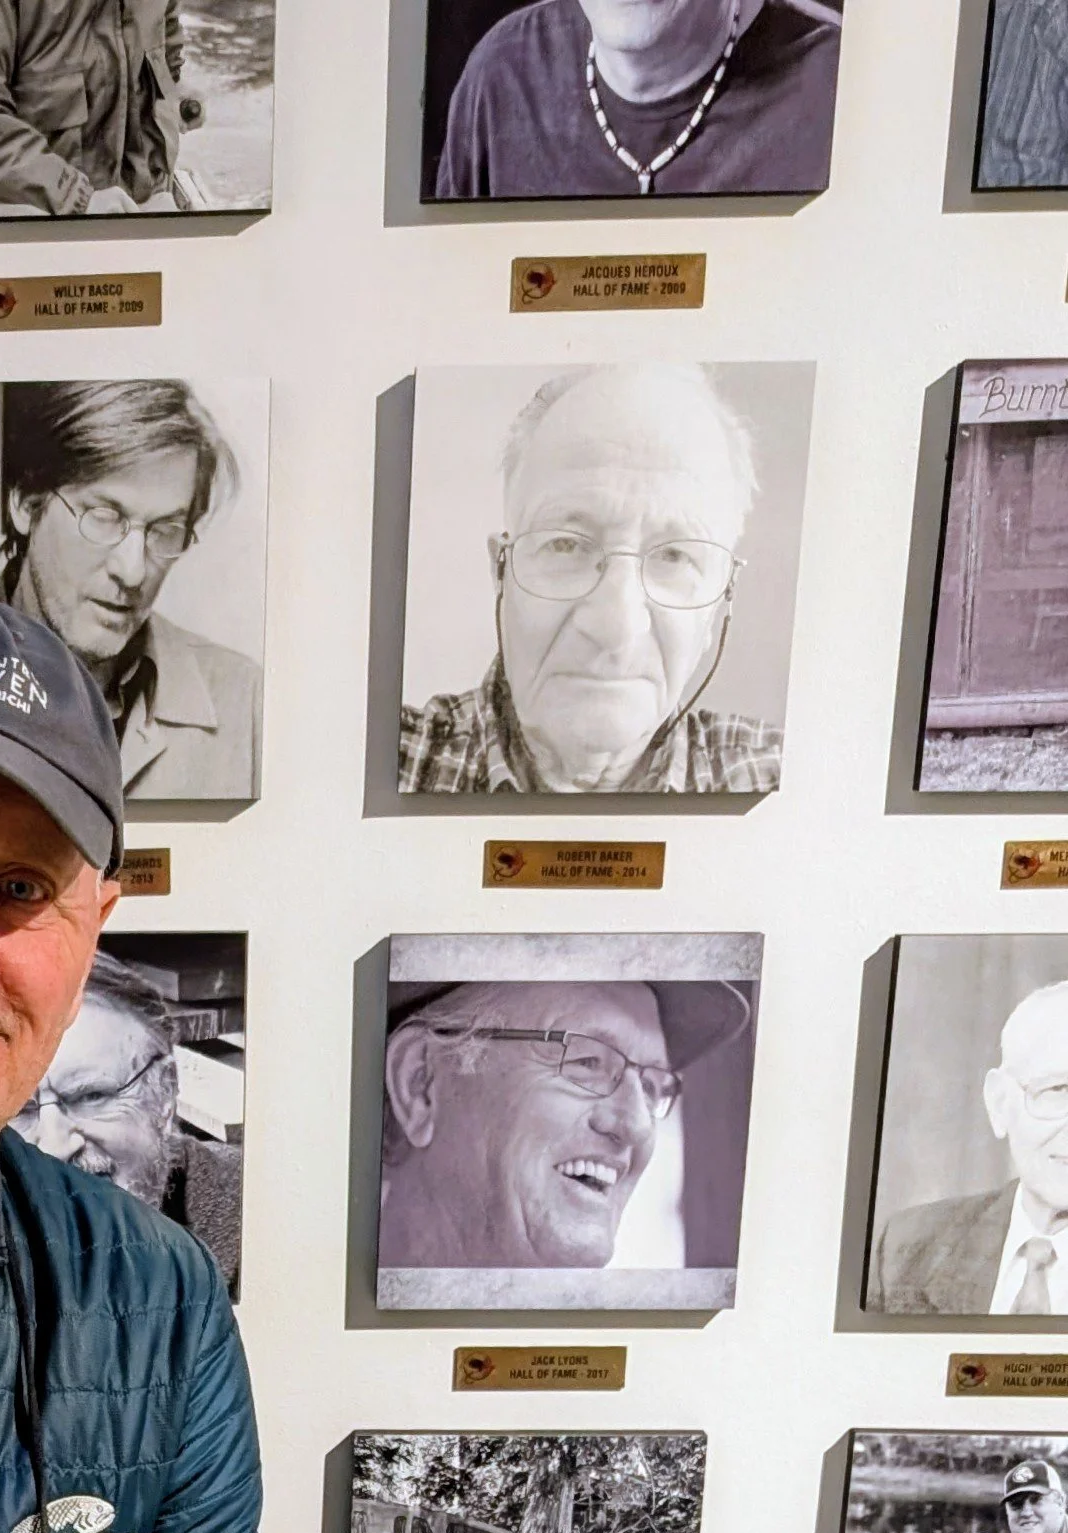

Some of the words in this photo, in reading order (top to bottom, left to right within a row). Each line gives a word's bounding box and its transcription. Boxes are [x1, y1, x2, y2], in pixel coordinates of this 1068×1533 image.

[582, 266, 631, 278] JACQUES
[634, 264, 680, 277] HEROUX
[54, 286, 85, 298] WILLY
[88, 284, 123, 297] BASCO
[573, 285, 599, 297] HALL
[604, 284, 617, 296] OF
[621, 283, 649, 296] FAME
[34, 304, 61, 316] HALL
[64, 303, 76, 315] OF
[80, 302, 108, 314] FAME
[119, 300, 144, 313] 2009
[557, 851, 596, 862] ROBERT
[599, 851, 632, 862] BAKER
[541, 866, 566, 877] HALL
[570, 866, 582, 877] OF
[586, 866, 613, 877] FAME
[622, 866, 646, 877] 2014
[531, 1356, 556, 1366] JACK
[558, 1356, 589, 1366] LYONS
[510, 1369, 533, 1380] HALL
[537, 1369, 549, 1380] OF
[552, 1369, 577, 1379] FAME
[586, 1369, 609, 1379] 2017
[1003, 1376, 1028, 1387] HALL
[1031, 1376, 1044, 1387] OF
